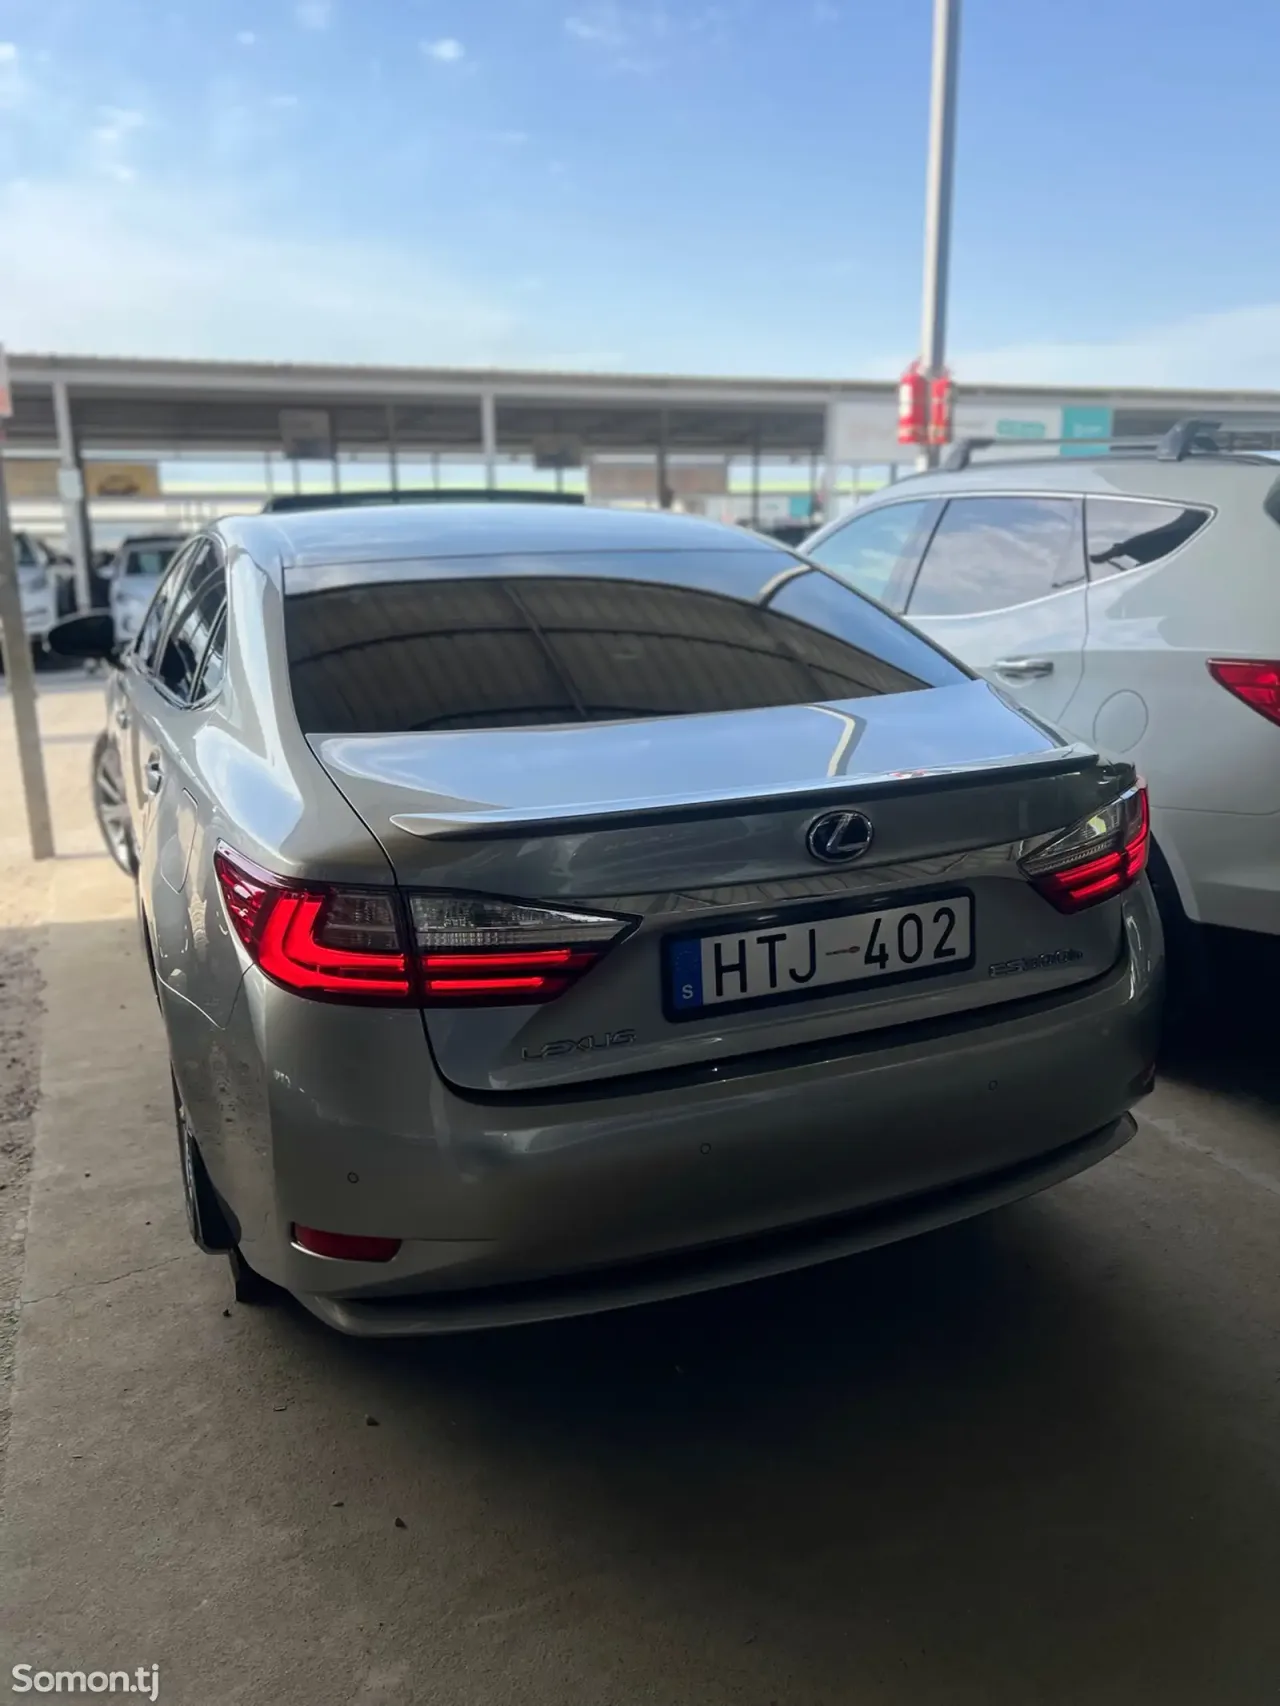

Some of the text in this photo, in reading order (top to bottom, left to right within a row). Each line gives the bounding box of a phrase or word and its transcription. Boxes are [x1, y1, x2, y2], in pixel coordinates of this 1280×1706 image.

[714, 906, 957, 997] HTJ 402
[681, 984, 694, 1000] S
[521, 1028, 637, 1061] LEXUS
